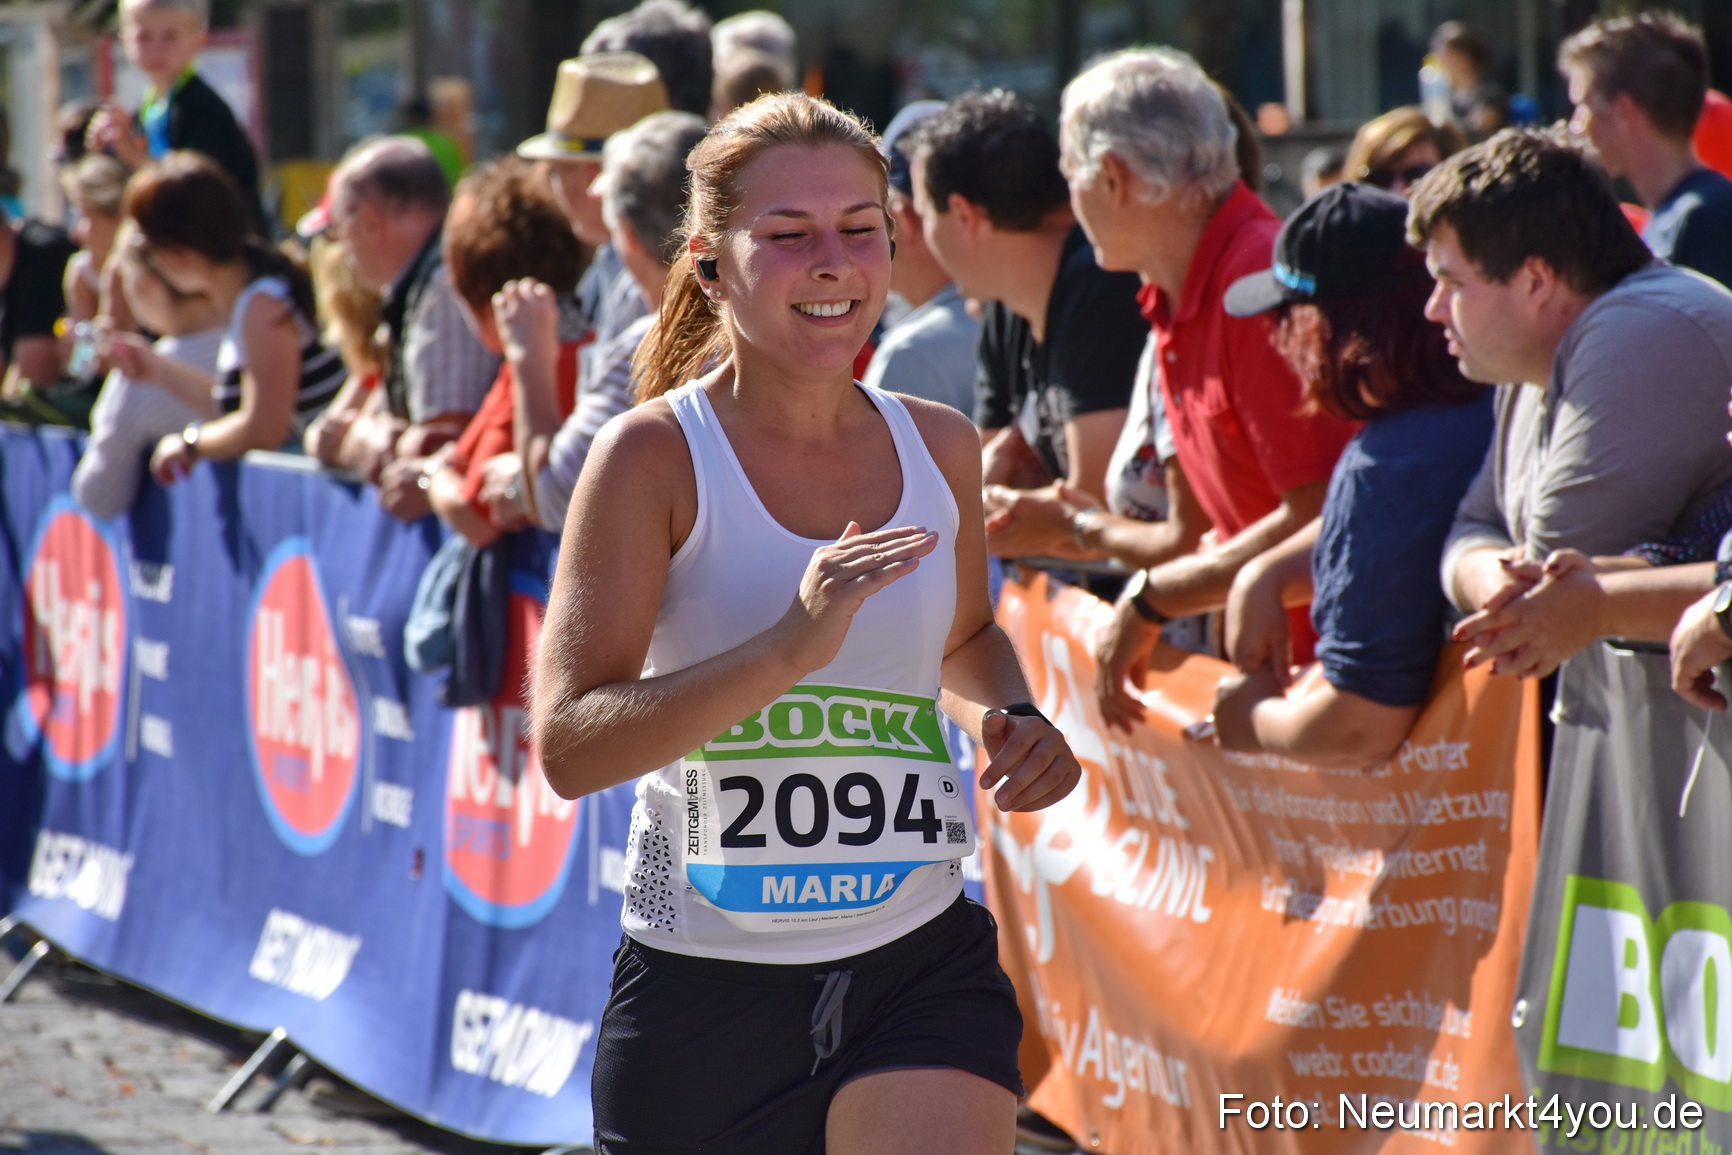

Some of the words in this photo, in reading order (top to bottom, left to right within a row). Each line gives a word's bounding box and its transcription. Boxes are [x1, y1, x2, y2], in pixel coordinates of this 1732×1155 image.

[704, 692, 934, 754] BOCK
[942, 780, 955, 793] D
[719, 772, 943, 849] 2094
[762, 874, 896, 904] MARIA
